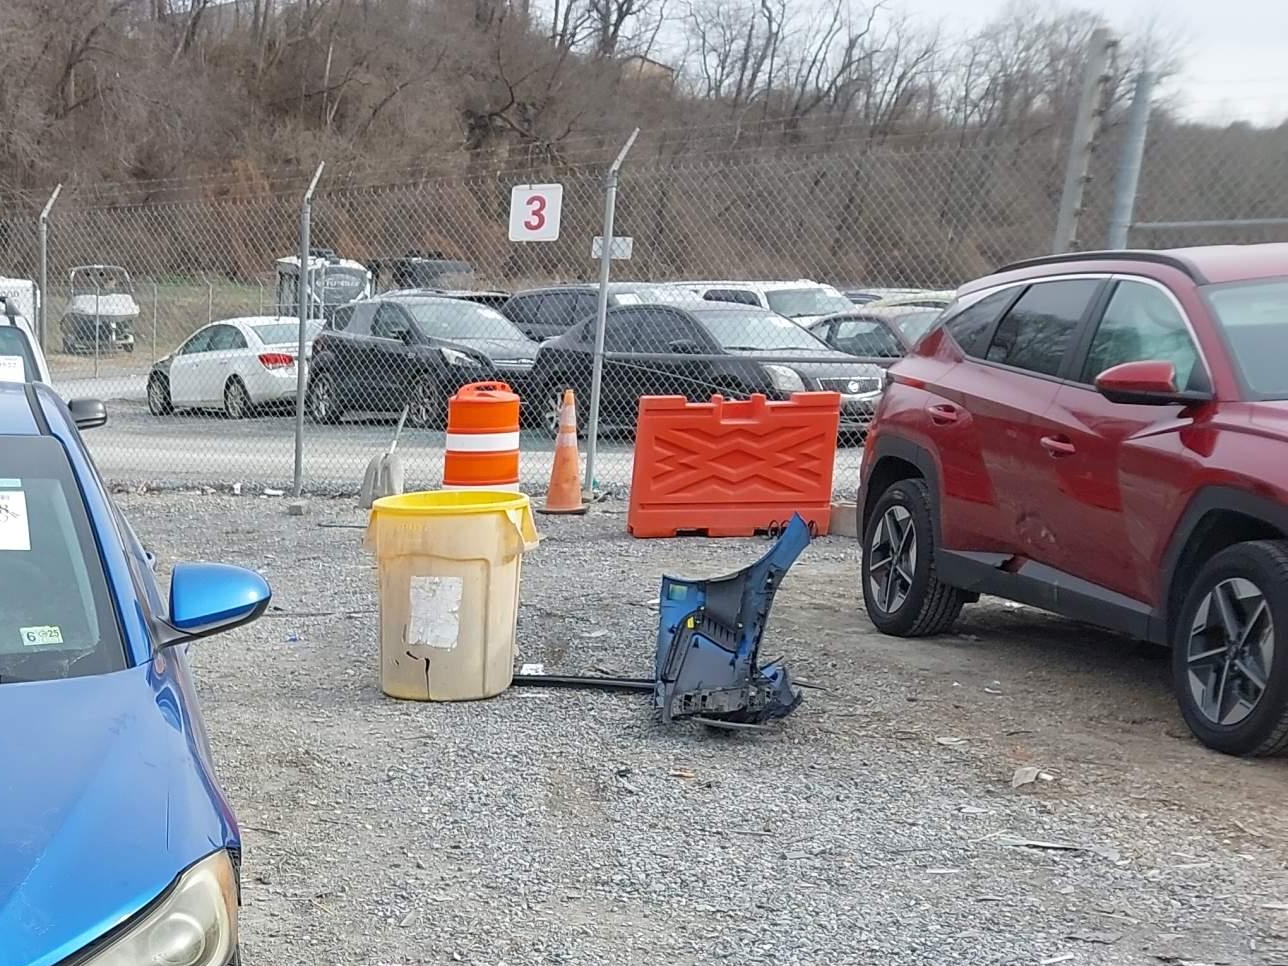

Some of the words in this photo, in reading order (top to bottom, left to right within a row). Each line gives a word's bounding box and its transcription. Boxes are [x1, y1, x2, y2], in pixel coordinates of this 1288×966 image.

[524, 195, 546, 230] 3
[26, 631, 37, 642] 6
[47, 629, 60, 638] 25
